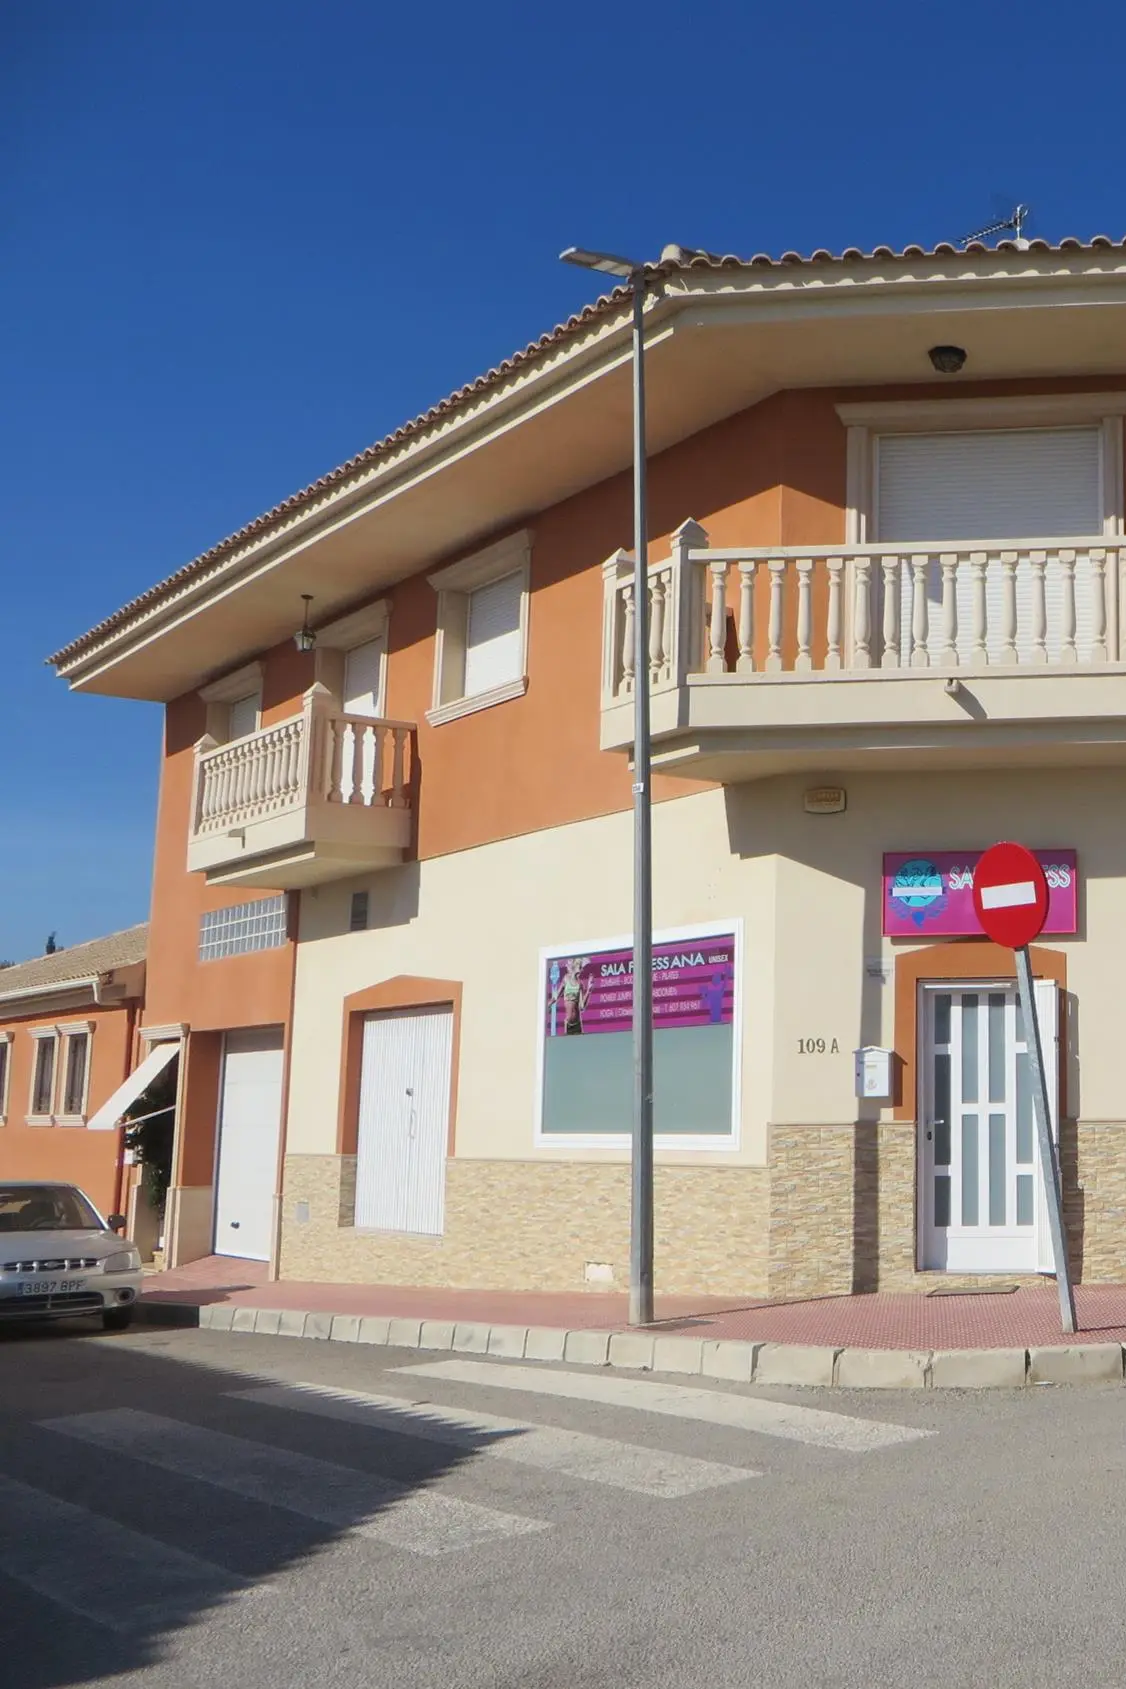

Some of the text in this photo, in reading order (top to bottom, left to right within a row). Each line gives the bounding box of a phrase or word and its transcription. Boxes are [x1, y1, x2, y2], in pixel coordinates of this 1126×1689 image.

[601, 952, 705, 977] SALA FESS ANA
[708, 954, 728, 963] UNISEX
[797, 1037, 840, 1054] 109 A
[25, 1281, 57, 1294] 3897
